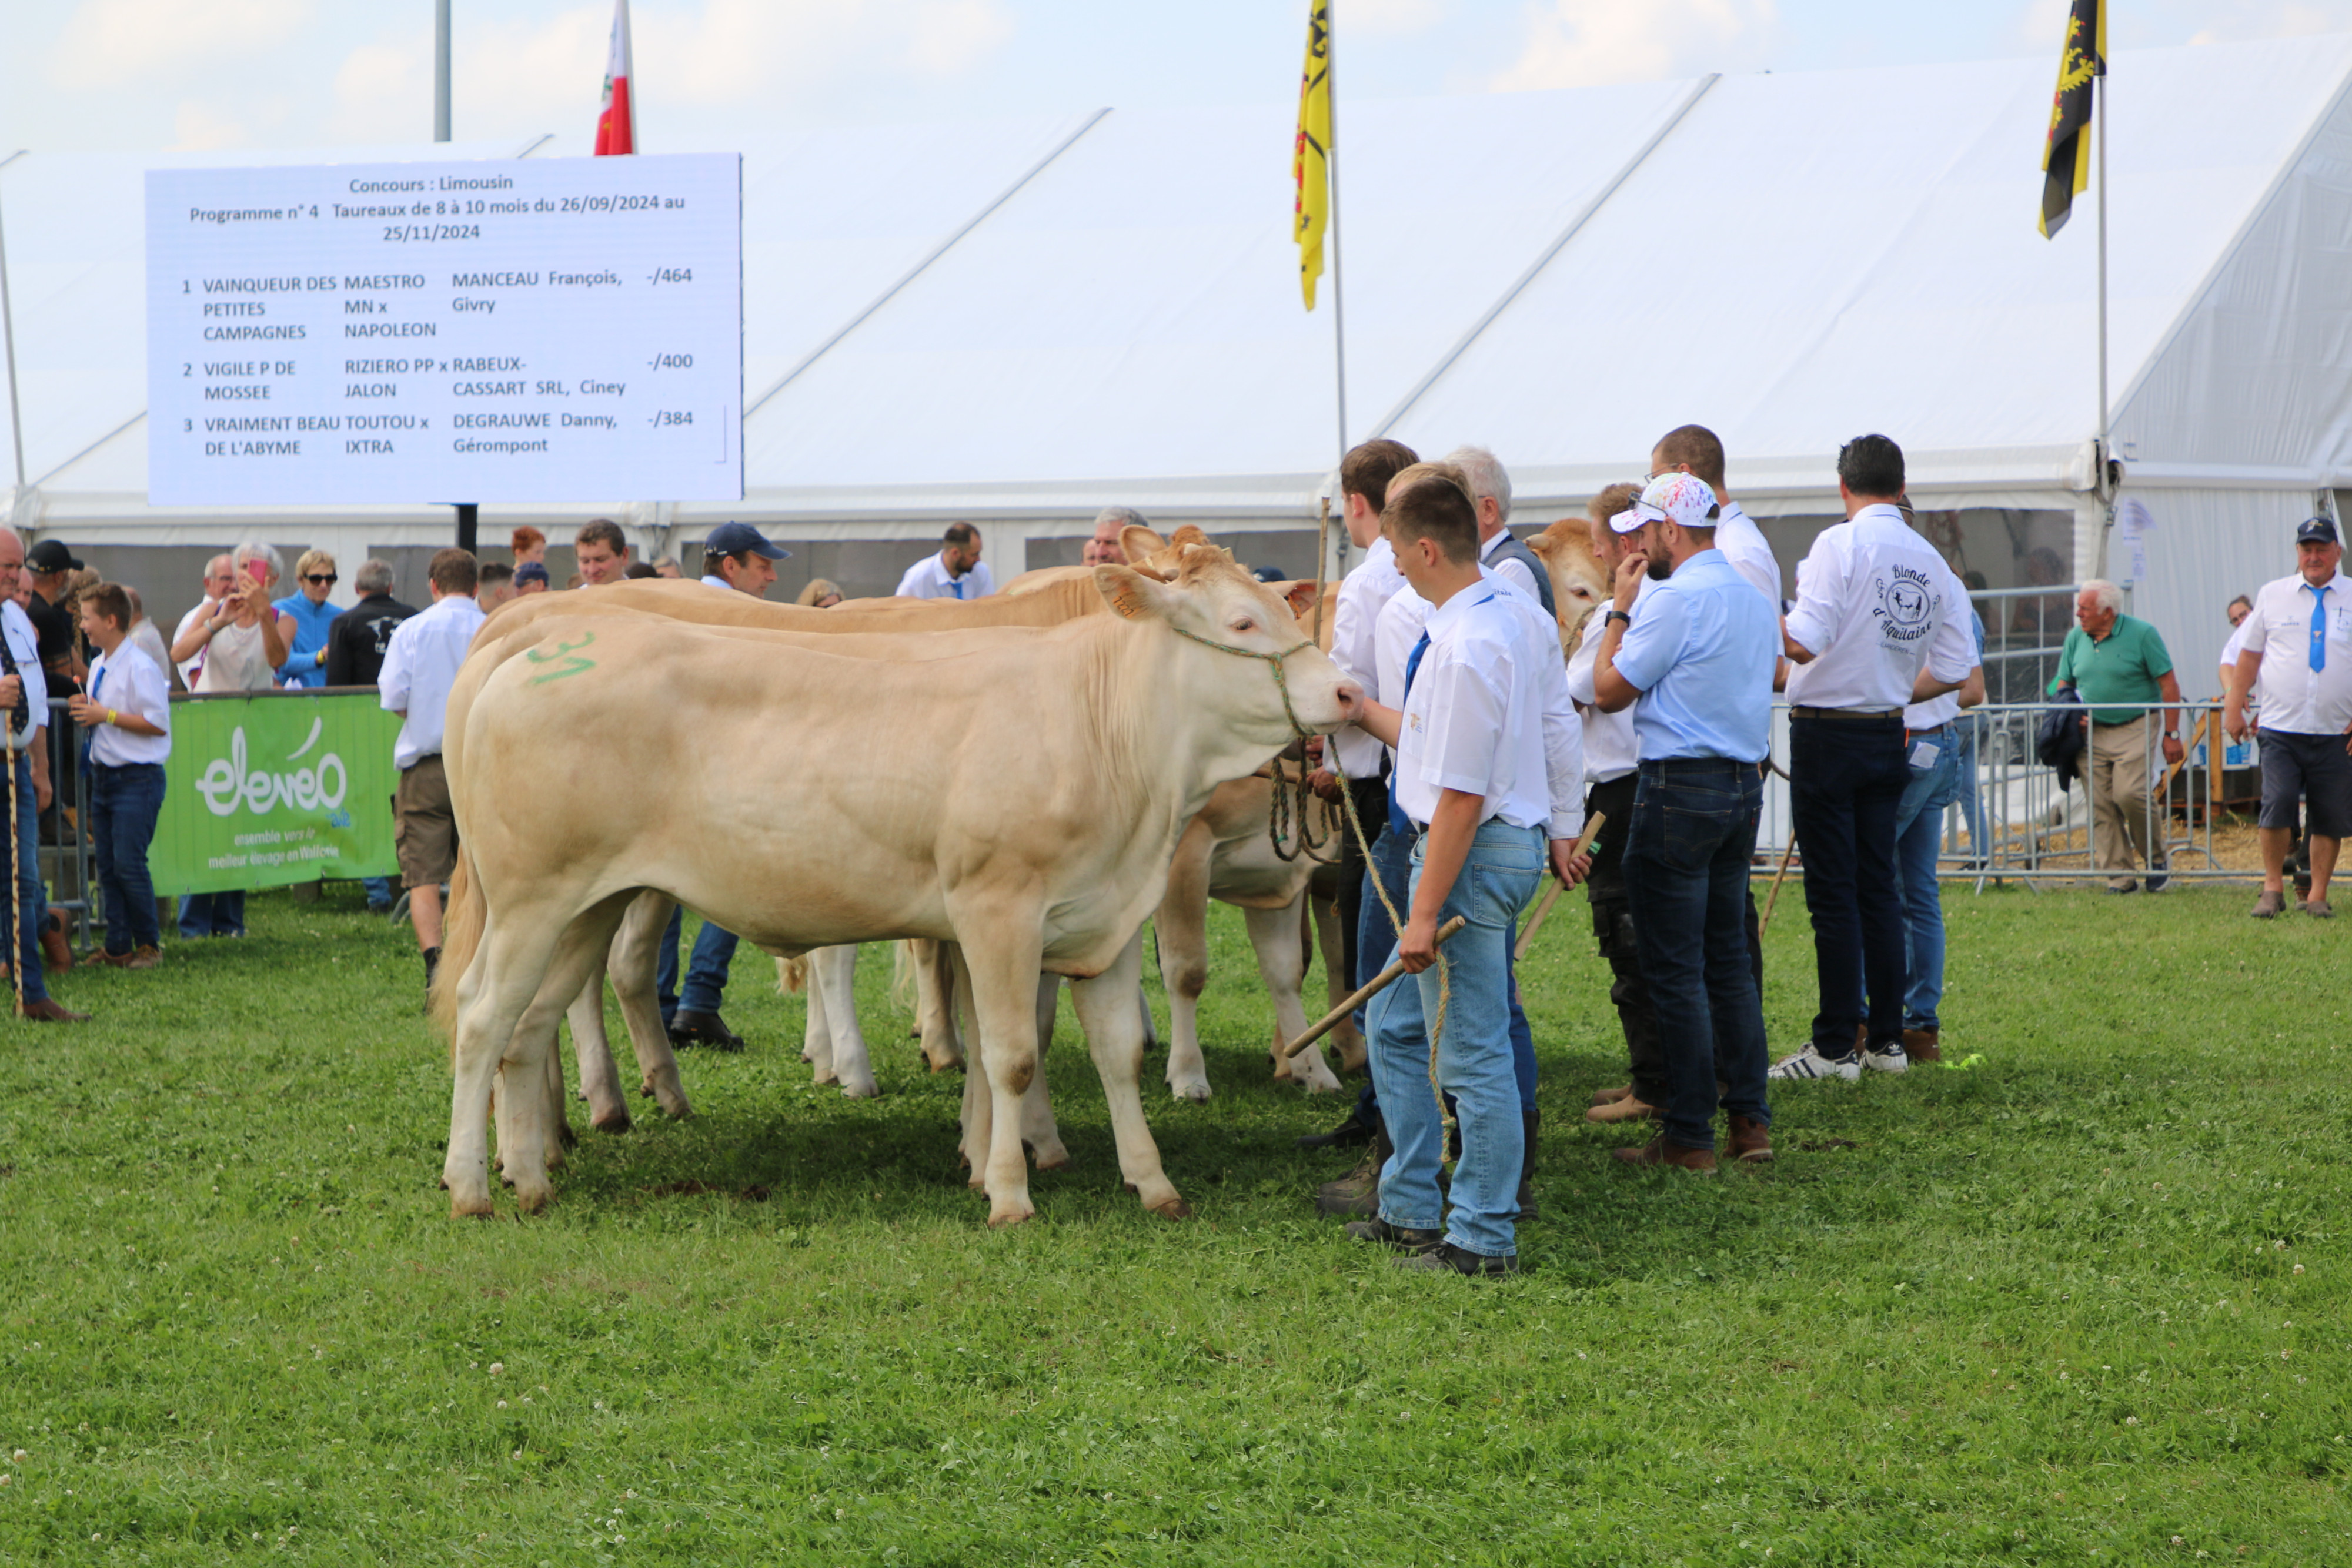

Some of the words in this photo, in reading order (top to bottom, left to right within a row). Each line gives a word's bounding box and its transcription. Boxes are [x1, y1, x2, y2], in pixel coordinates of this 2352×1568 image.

[349, 179, 425, 193] Concours
[430, 180, 434, 190] :
[440, 174, 513, 190] Limousin
[190, 208, 283, 224] Programme
[288, 204, 304, 219] n°
[309, 204, 319, 218] 4
[332, 203, 406, 218] Taureaux
[411, 201, 431, 216] de
[436, 201, 446, 215] 8
[450, 200, 460, 215] à
[466, 200, 485, 215] 10
[490, 198, 529, 213] mois
[534, 198, 555, 212] du
[560, 195, 660, 214] 26/09/2024
[664, 198, 685, 209] au
[383, 224, 480, 243] 25/11/2024
[183, 280, 191, 294] 1
[203, 277, 302, 293] VAINQUEUR
[306, 276, 337, 291] DES
[344, 274, 425, 290] MAESTRO
[452, 272, 539, 287] MANCEAU
[549, 269, 622, 287] François,
[647, 267, 693, 286] -/464
[203, 302, 265, 317] PETITES
[345, 300, 373, 314] MN
[379, 303, 387, 313] x
[452, 297, 496, 314] Givry
[203, 325, 306, 340] CAMPAGNES
[345, 322, 436, 338] NAPOLEON
[183, 363, 192, 377] 2
[204, 362, 254, 376] VIGILE
[260, 361, 270, 375] P
[275, 360, 295, 375] DE
[345, 359, 409, 374] RIZIERO
[414, 358, 435, 373] PP
[439, 362, 447, 372] x
[453, 357, 526, 372] RABEUX-
[647, 353, 693, 371] -/400
[205, 385, 270, 400] MOSSEE
[345, 383, 396, 398] JALON
[453, 381, 526, 396] CASSART
[536, 380, 570, 397] SRL,
[580, 379, 626, 397] Ciney
[185, 418, 193, 432] 3
[205, 417, 292, 432] VRAIMENT
[297, 416, 340, 430] BEAU
[346, 415, 415, 430] TOUTOU
[420, 418, 429, 429] x
[453, 413, 550, 429] DEGRAUWE
[561, 413, 617, 430] Danny,
[647, 410, 693, 428] -/384
[205, 442, 225, 456] DE
[231, 440, 300, 456] L'ABYME
[346, 439, 394, 454] IXTRA
[453, 438, 548, 455] Gérompont
[1892, 564, 1930, 587] Blonde
[234, 829, 280, 847] ensemble
[284, 830, 305, 842] vers
[208, 854, 247, 869] meilleur
[286, 850, 299, 862] en
